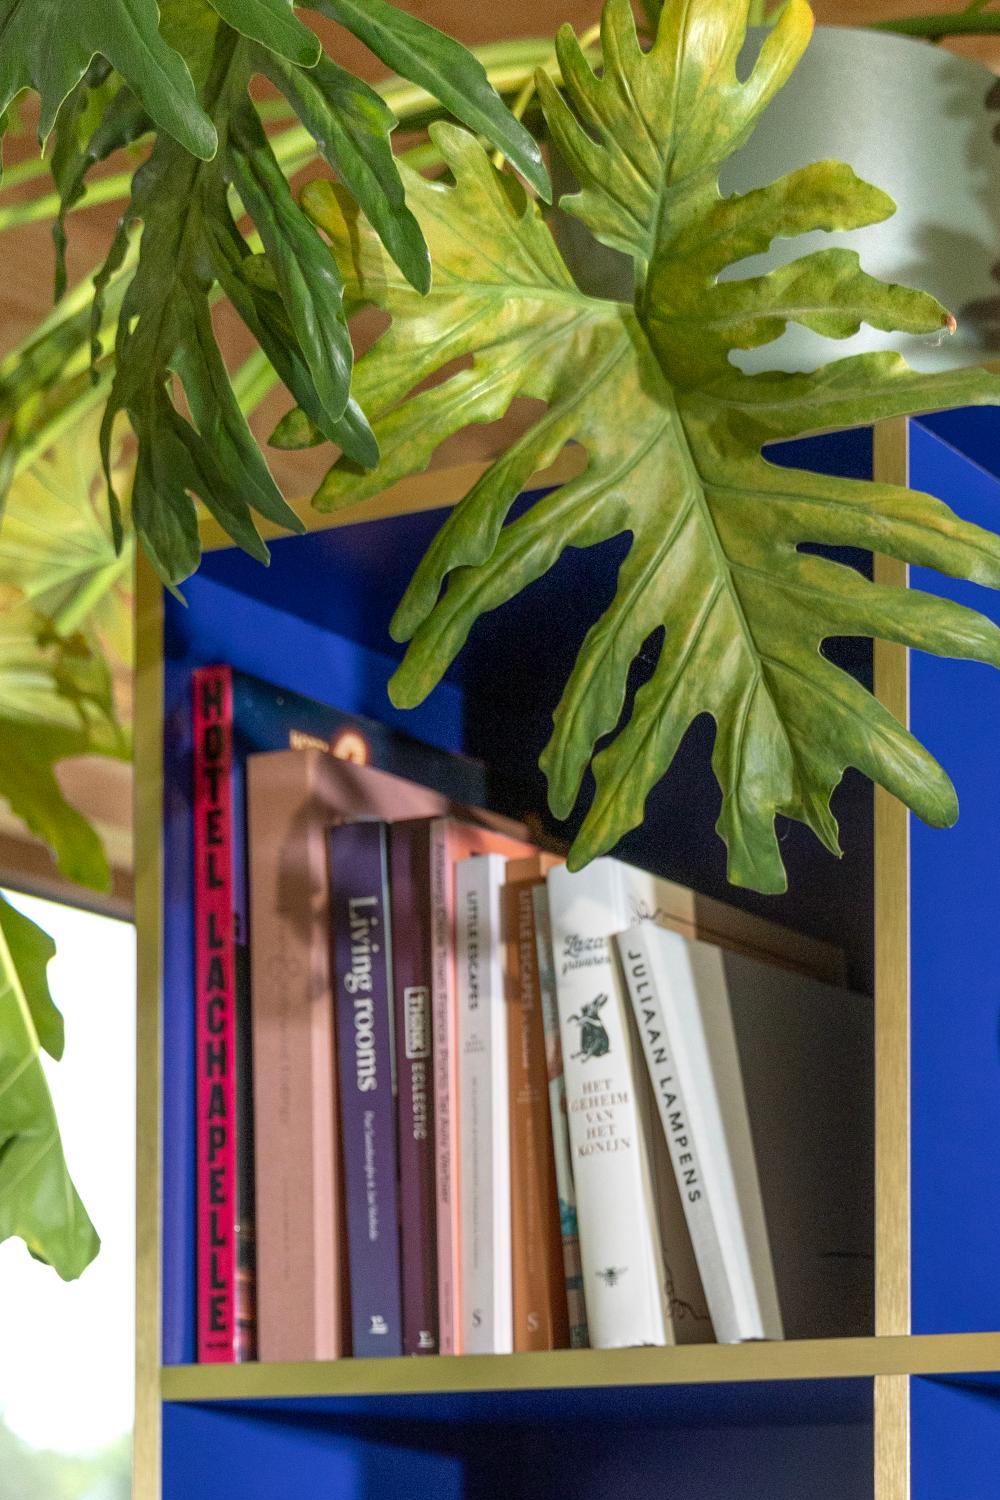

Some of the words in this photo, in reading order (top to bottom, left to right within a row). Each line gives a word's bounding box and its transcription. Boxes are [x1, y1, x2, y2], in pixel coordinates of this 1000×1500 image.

[203, 680, 223, 889] HOTEL
[344, 896, 380, 994] Living
[466, 890, 478, 937] LITTLE
[519, 889, 532, 938] LITTLE
[467, 942, 480, 1011] ESCAPES
[520, 942, 534, 1010] ESCAPES
[353, 998, 378, 1092] rooms
[628, 951, 666, 1064] JULIAAN
[659, 1076, 702, 1203] LAMPENS
[411, 1062, 427, 1140] ECLECTIC
[582, 1078, 611, 1095] HET
[585, 1108, 613, 1123] VAN
[206, 912, 228, 1331] LACHAPELLE
[586, 1124, 616, 1140] HET
